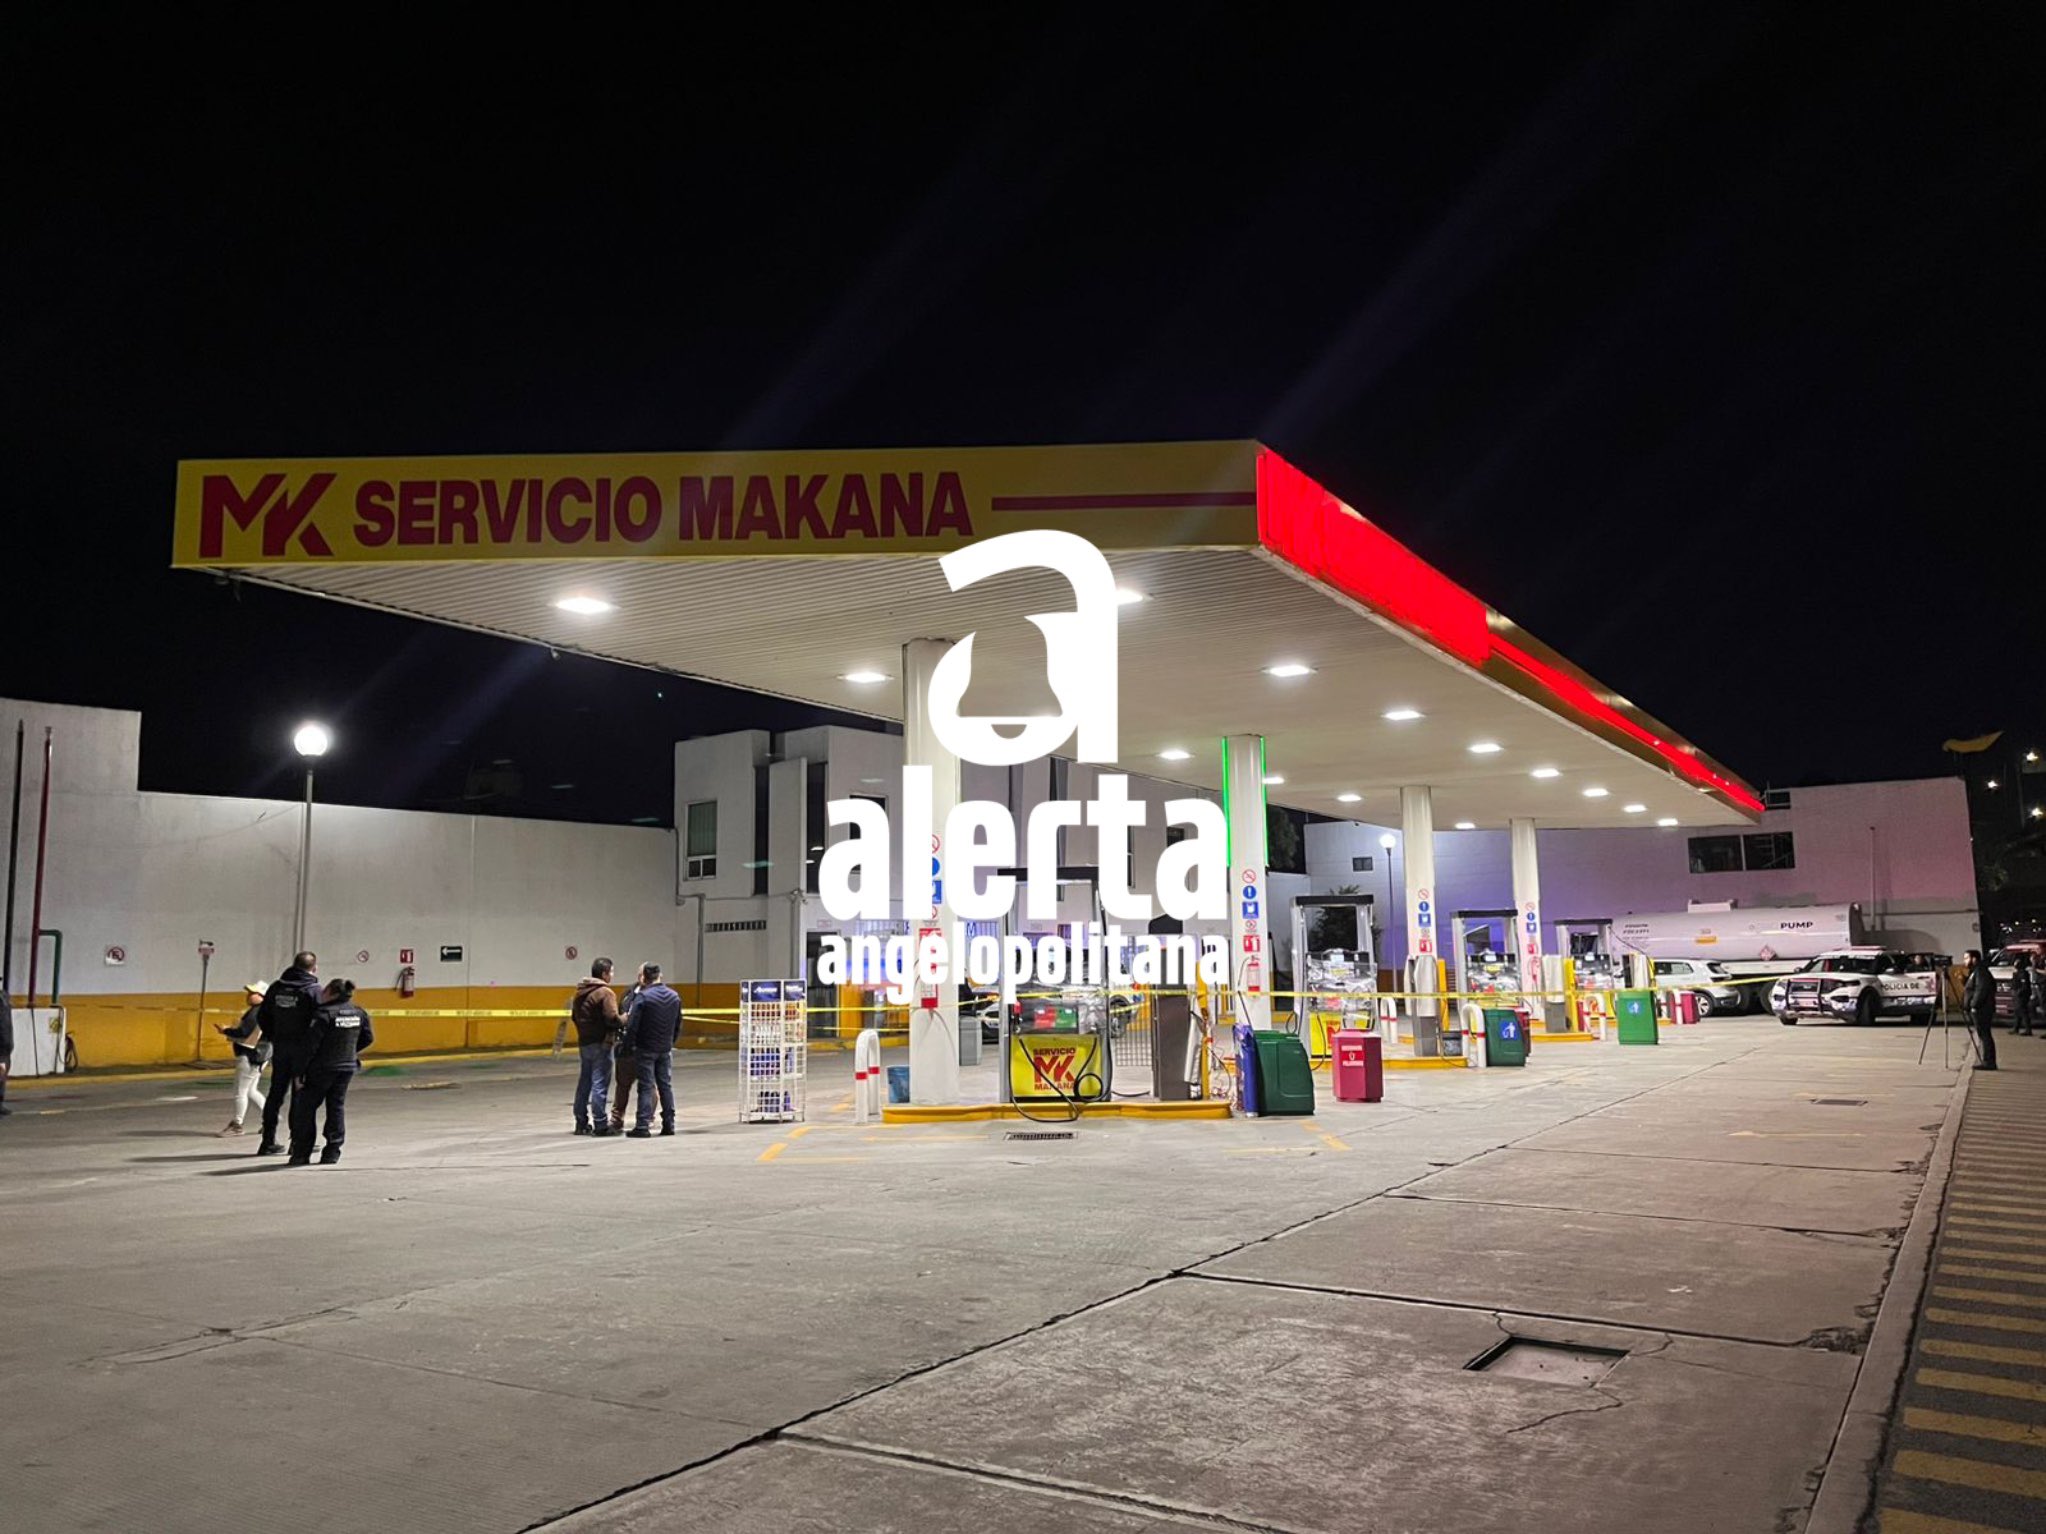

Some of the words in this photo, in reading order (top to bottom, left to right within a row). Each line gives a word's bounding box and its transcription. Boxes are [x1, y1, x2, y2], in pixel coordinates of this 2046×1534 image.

[353, 476, 662, 547] SERVICIO
[679, 472, 973, 540] MAKANA
[1780, 921, 1813, 929] PUMP
[1034, 1082, 1075, 1090] MAAN
